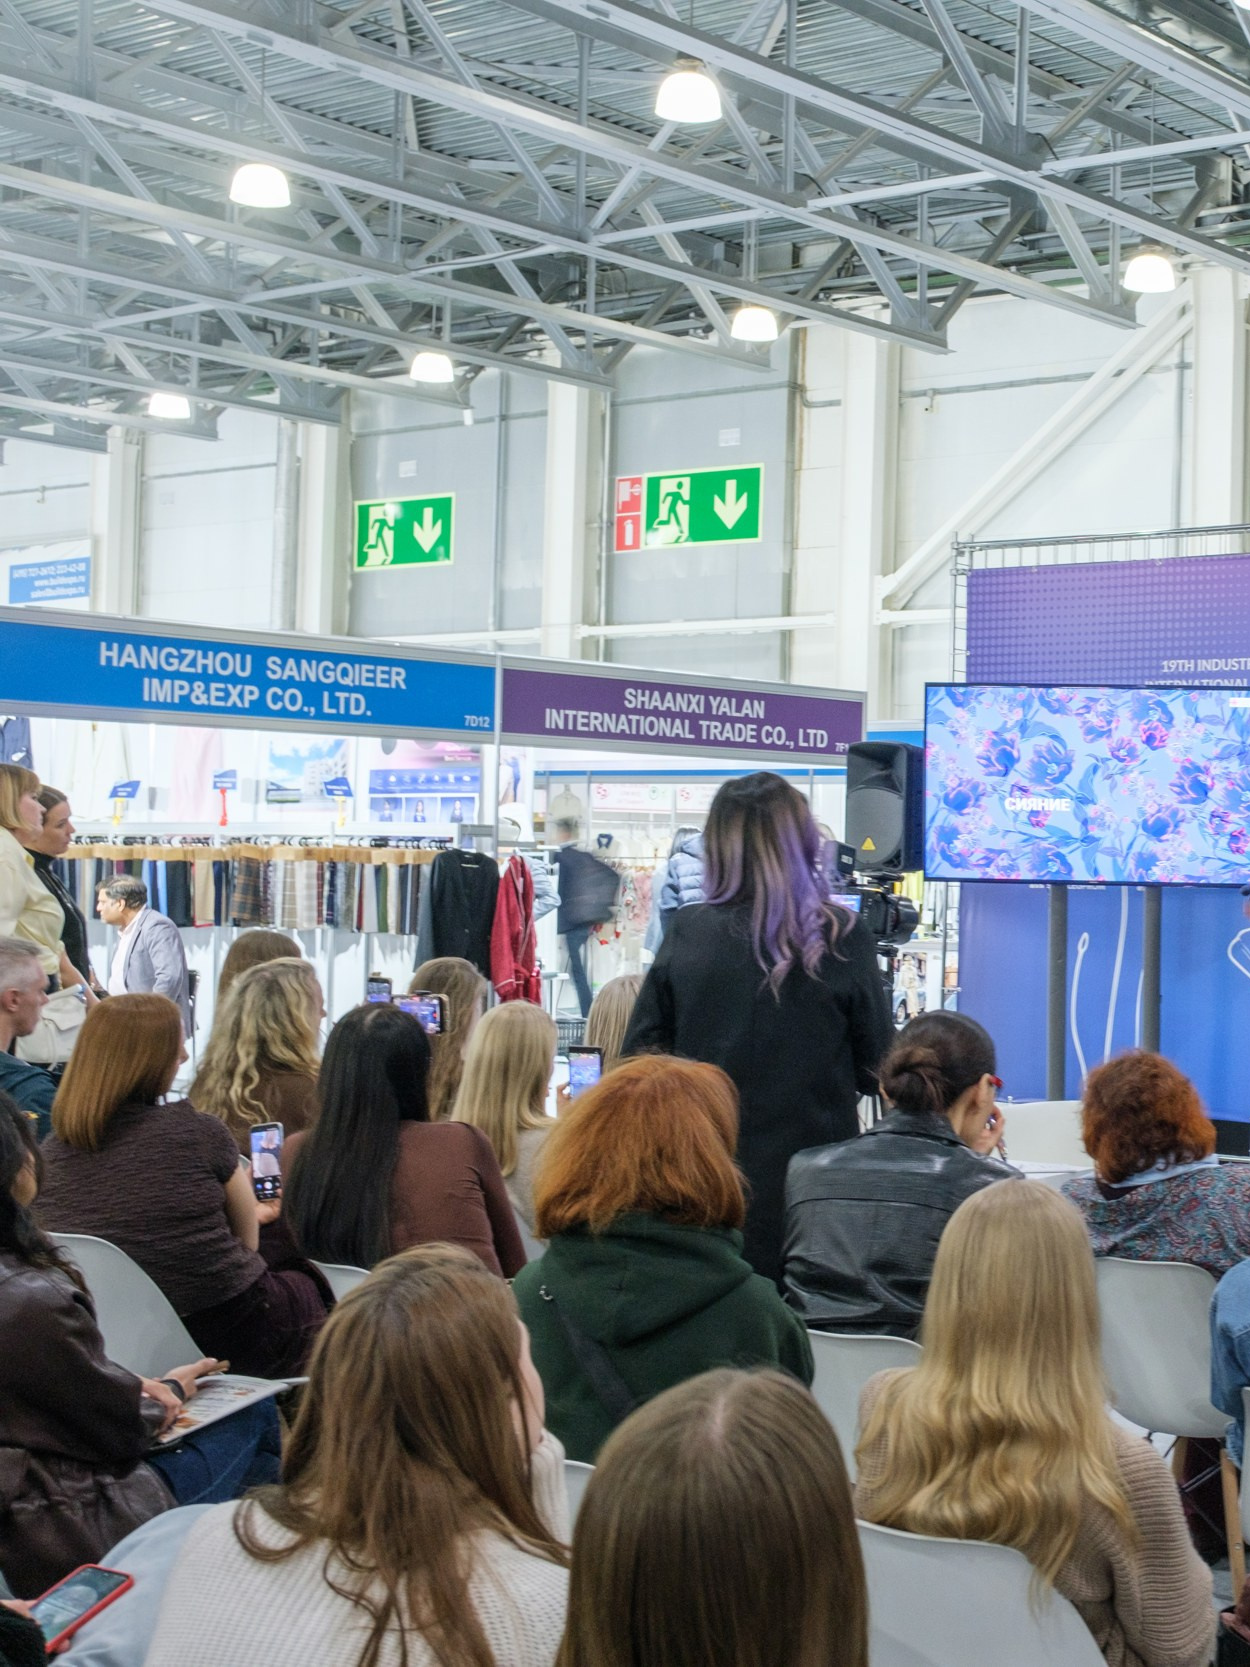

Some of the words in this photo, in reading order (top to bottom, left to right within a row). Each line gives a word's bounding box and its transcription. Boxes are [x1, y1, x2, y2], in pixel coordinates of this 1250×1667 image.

[100, 641, 252, 677] HANGZHOU
[266, 656, 407, 689] SANGQIEER
[1162, 659, 1194, 672] 19TH
[143, 677, 259, 708] IMP&EXP
[266, 687, 315, 716] CO.,
[322, 691, 372, 717] LTD.
[624, 688, 705, 714] SHAANXI
[709, 695, 765, 719] YALAN
[464, 715, 490, 728] 7D12
[545, 708, 695, 738] INTERNATIONAL
[699, 720, 757, 743] TRADE
[761, 725, 794, 749] CO.,
[799, 728, 828, 748] LTD
[1004, 797, 1071, 811] СИЯНИЕ
